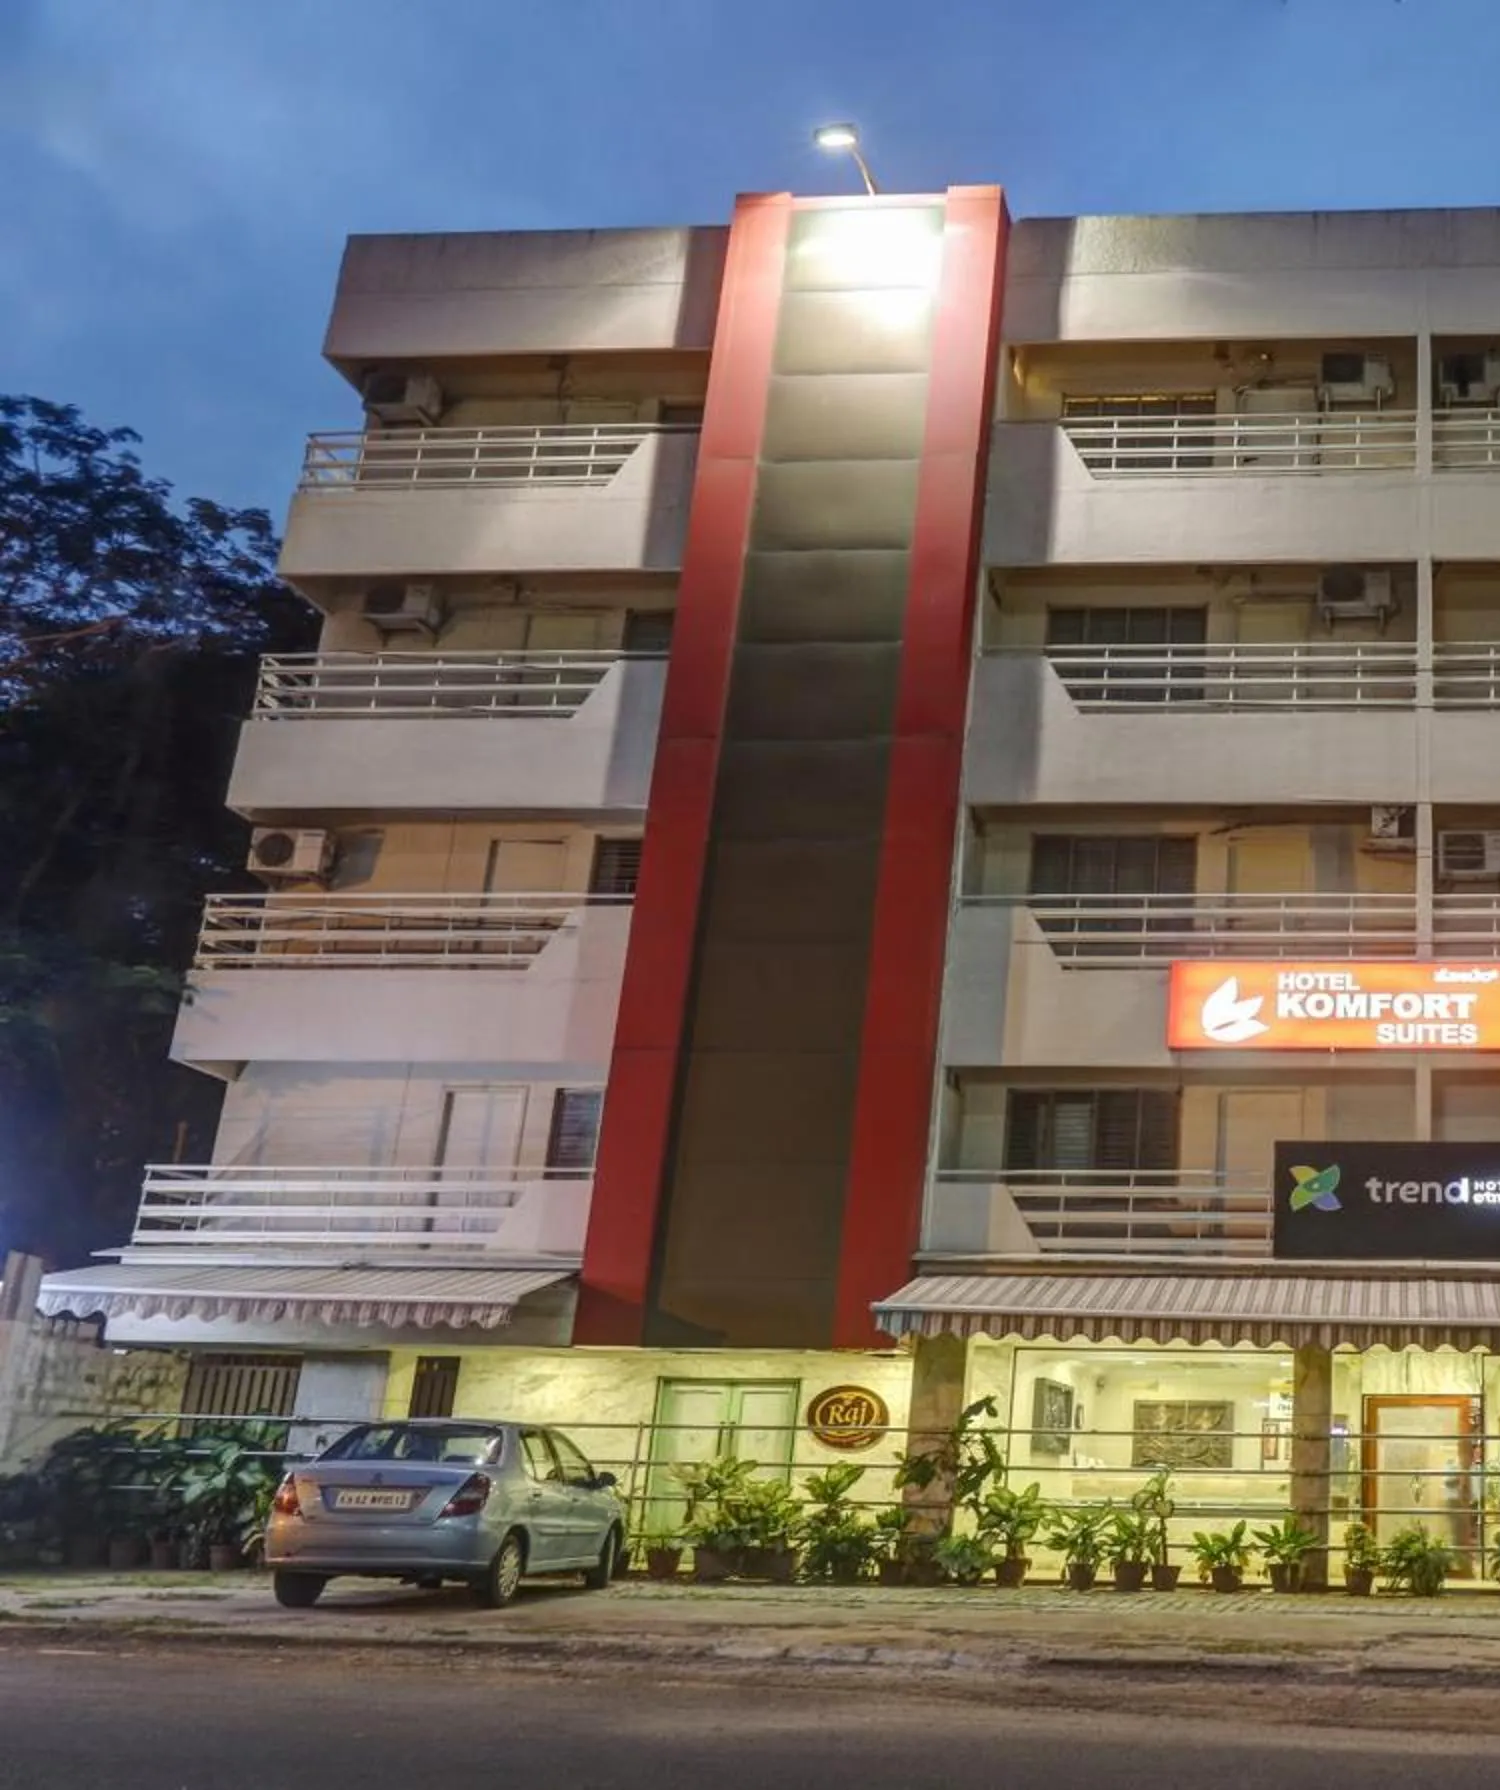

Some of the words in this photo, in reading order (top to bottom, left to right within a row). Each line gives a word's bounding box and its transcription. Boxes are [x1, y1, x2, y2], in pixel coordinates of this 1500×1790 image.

[1277, 972, 1361, 990] HOTEL
[1276, 992, 1478, 1019] KOMFORT
[1376, 1023, 1478, 1044] SUITES
[1364, 1177, 1469, 1204] trend
